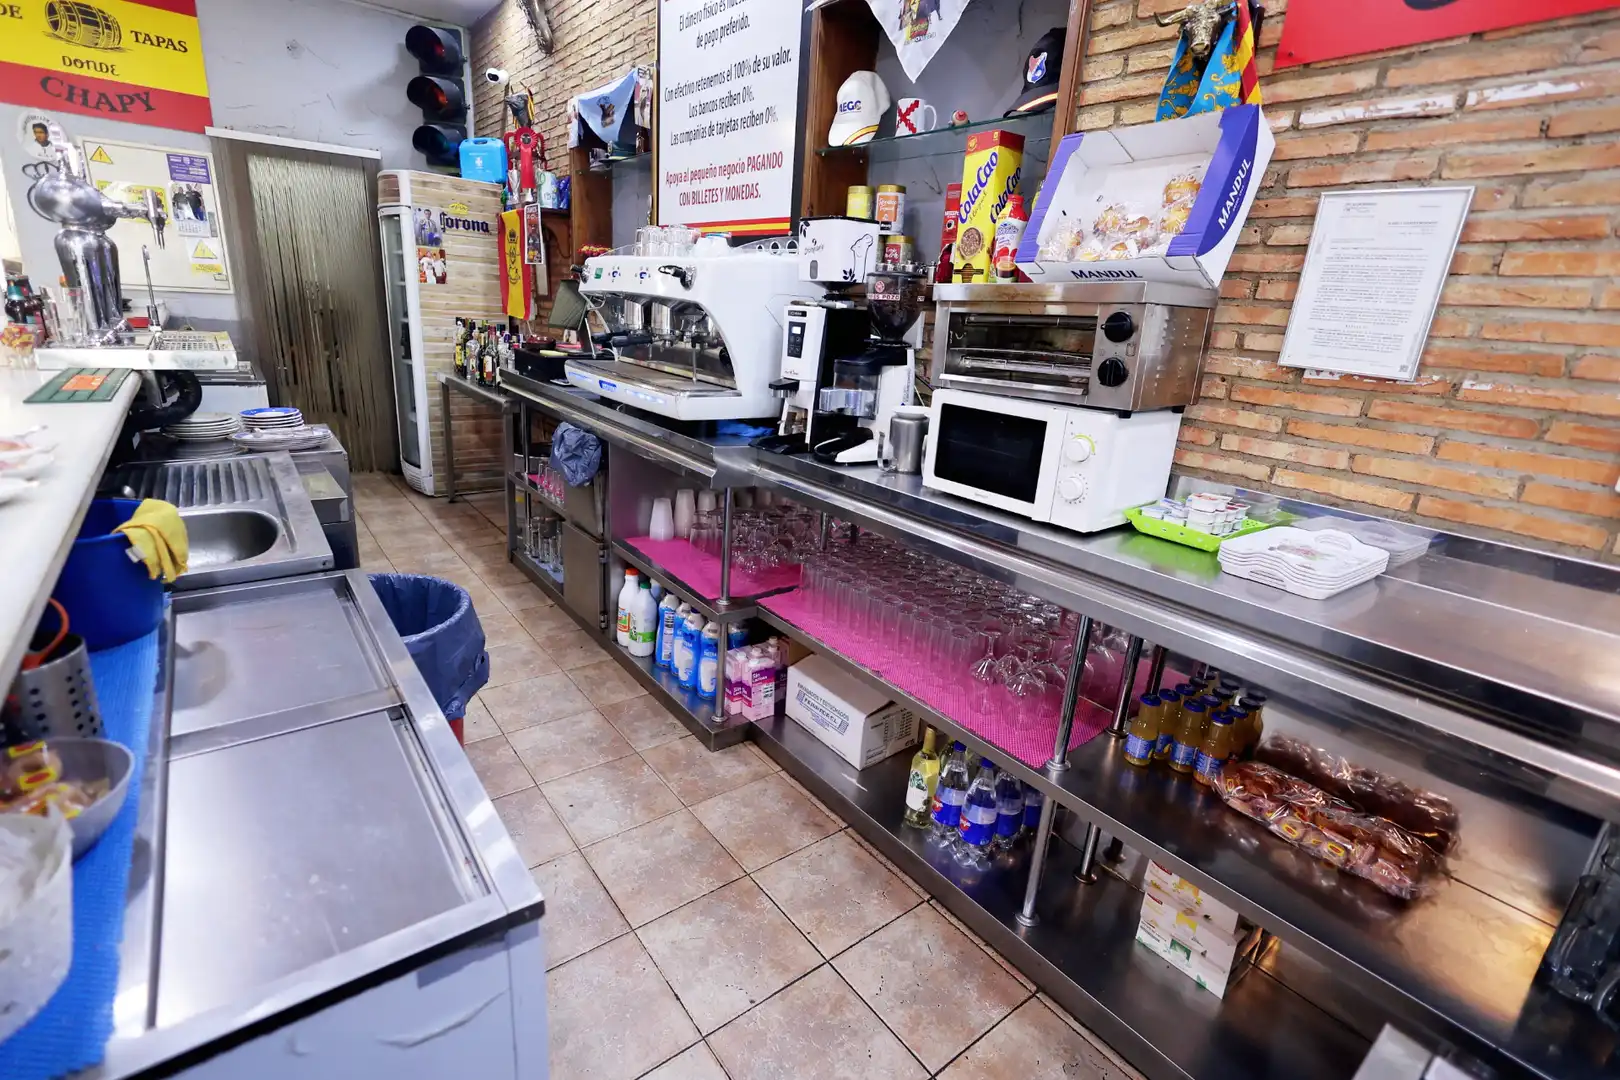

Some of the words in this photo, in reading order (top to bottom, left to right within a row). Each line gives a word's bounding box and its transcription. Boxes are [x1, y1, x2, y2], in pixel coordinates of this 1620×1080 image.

[679, 15, 684, 31] El
[685, 10, 702, 29] dinero
[696, 29, 704, 48] de
[704, 28, 718, 50] pago
[720, 12, 750, 43] preferido.
[130, 30, 188, 53] TAPAS
[664, 87, 674, 102] Con
[674, 80, 695, 99] efectivo
[695, 71, 726, 92] retenemos
[726, 63, 733, 82] el
[733, 58, 751, 80] 100%
[752, 54, 761, 73] de
[762, 56, 770, 71] su
[771, 46, 792, 68] valor.
[40, 76, 156, 113] CHAPY
[688, 102, 698, 118] Los
[698, 99, 718, 116] bancos
[718, 90, 741, 109] reciben
[741, 85, 755, 104] 0%.
[670, 131, 679, 146] Las
[679, 124, 707, 146] compañías
[707, 121, 715, 137] de
[716, 117, 739, 138] tarjetas
[739, 110, 764, 129] reciben
[665, 171, 683, 188] Apoya
[683, 168, 690, 182] al
[690, 163, 717, 185] pequeño
[718, 158, 746, 180] negocio
[746, 151, 783, 173] PAGANDO
[679, 192, 691, 206] CON
[691, 188, 719, 206] BILLETES
[719, 187, 724, 203] Y
[725, 182, 761, 201] MONEDAS.
[959, 151, 998, 225] ColaCao
[1217, 158, 1252, 230] MANDUL
[440, 211, 490, 233] Corona
[1071, 269, 1143, 280] MANDUL
